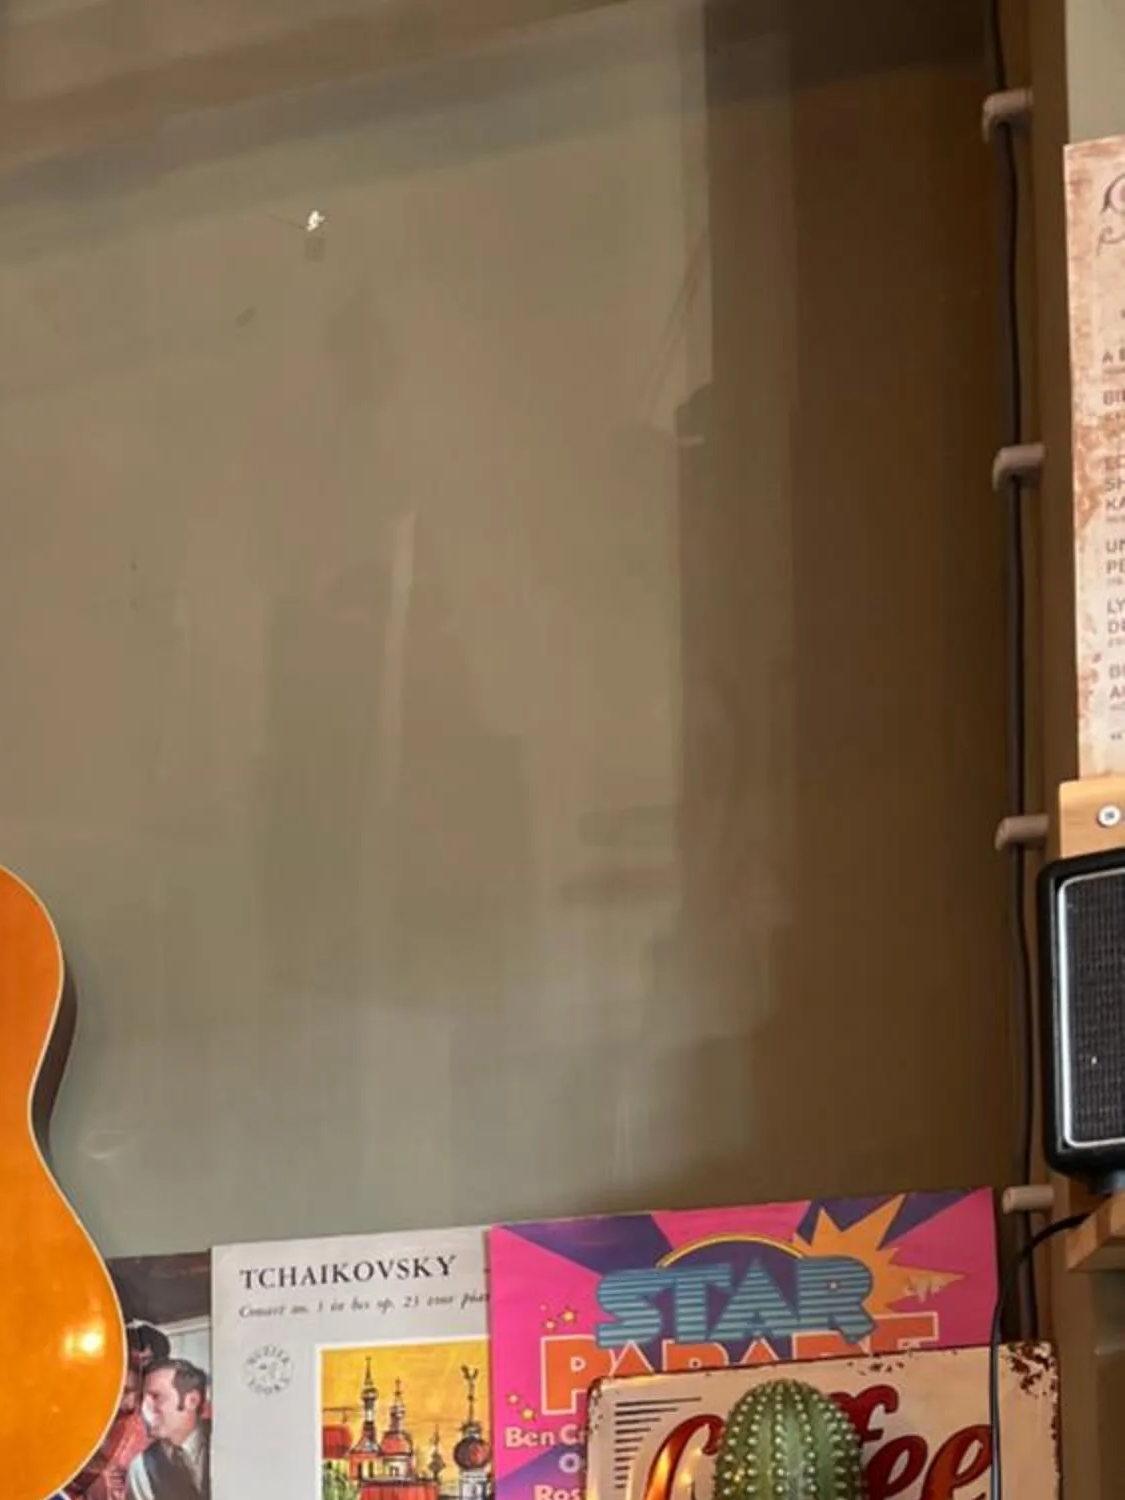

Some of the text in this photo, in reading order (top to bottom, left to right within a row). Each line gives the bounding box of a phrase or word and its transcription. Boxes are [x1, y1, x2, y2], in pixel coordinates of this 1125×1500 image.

[239, 1254, 457, 1291] TCHAIKOVSKY
[595, 1256, 875, 1348] STAR
[505, 1427, 555, 1448] Ben
